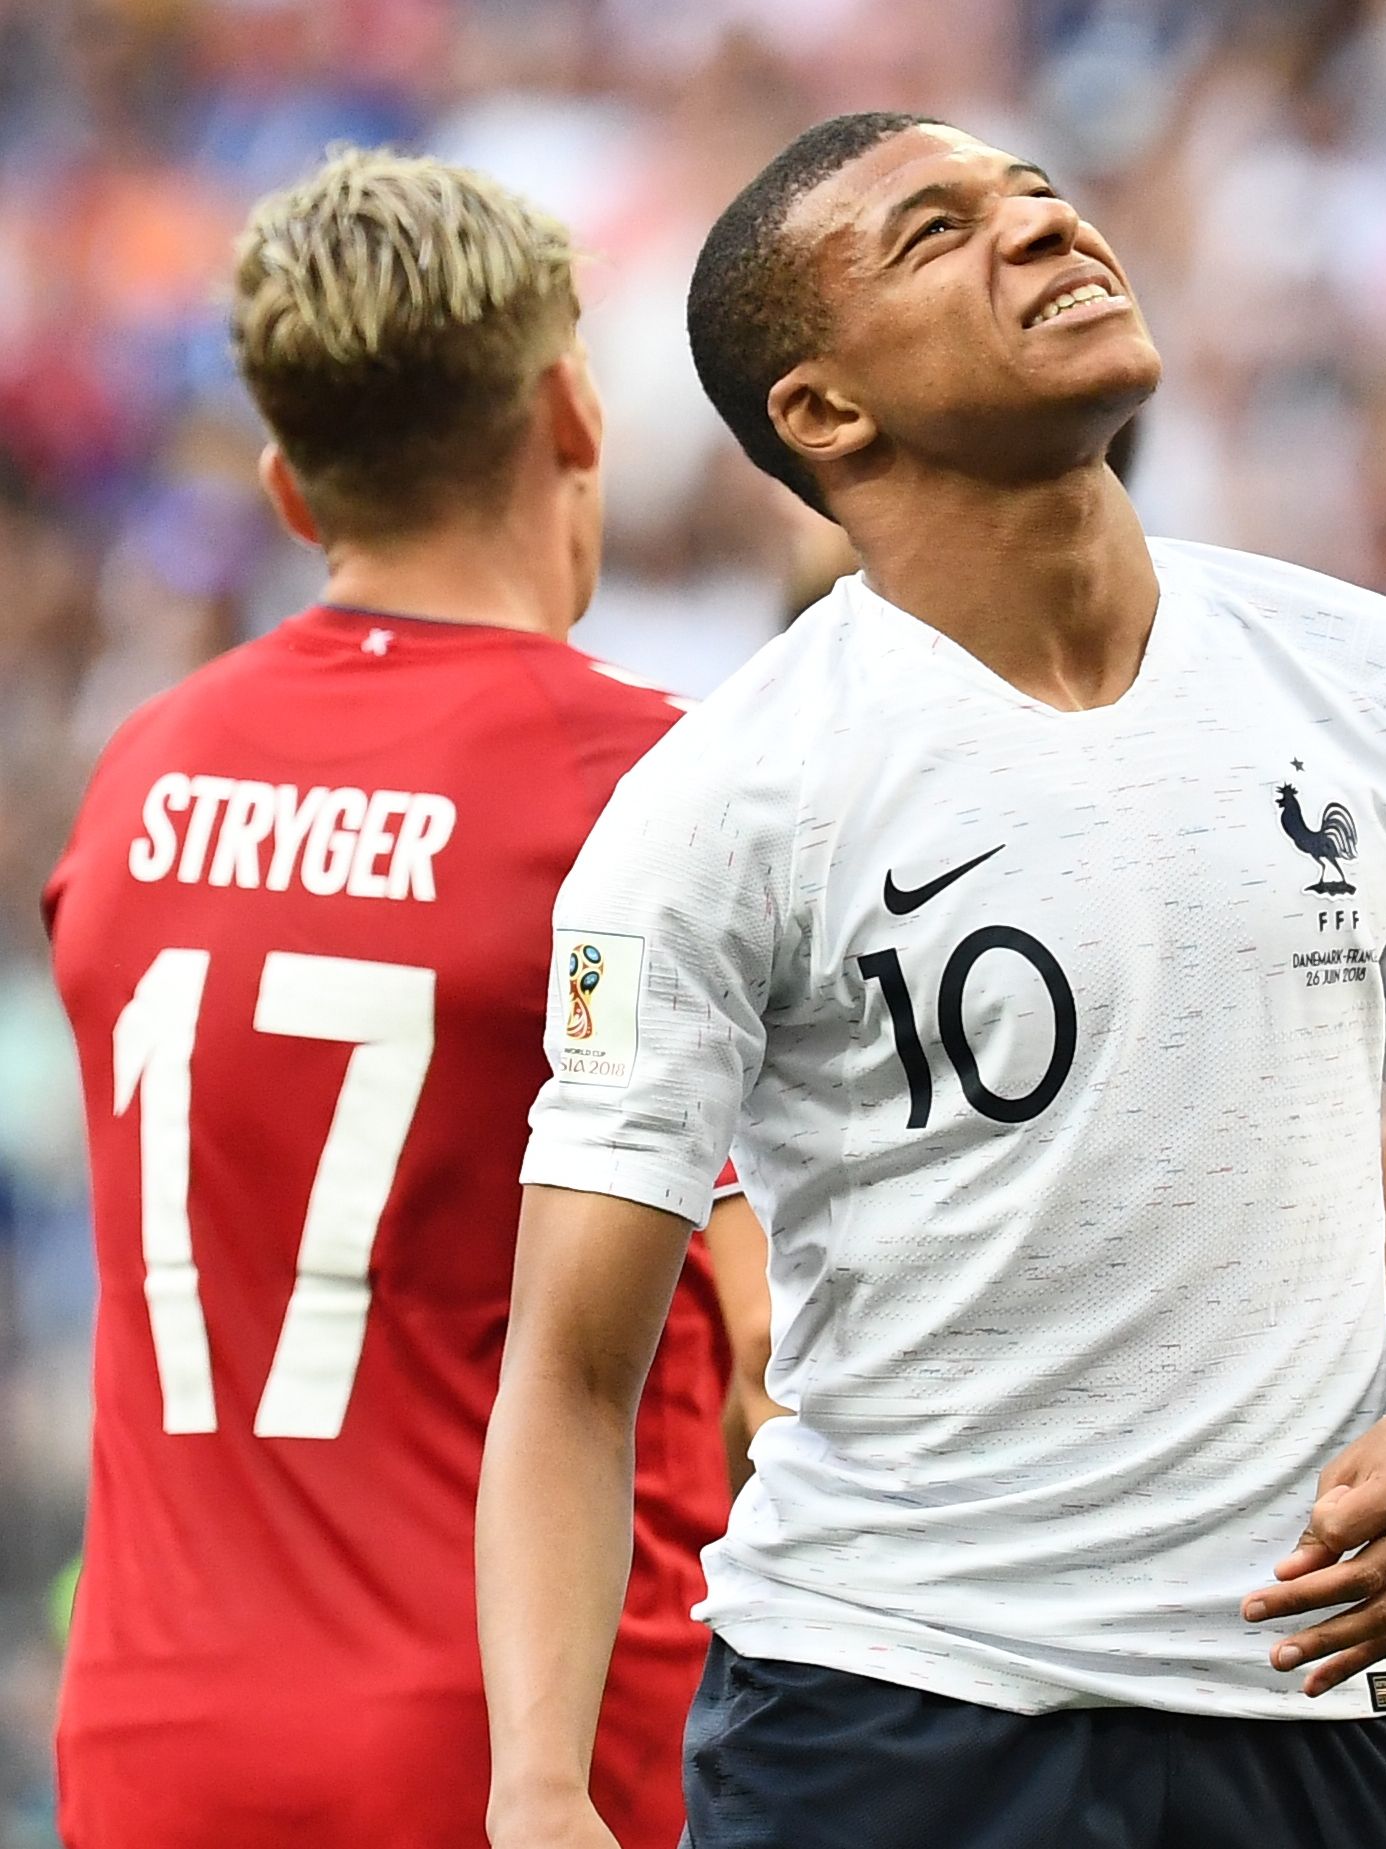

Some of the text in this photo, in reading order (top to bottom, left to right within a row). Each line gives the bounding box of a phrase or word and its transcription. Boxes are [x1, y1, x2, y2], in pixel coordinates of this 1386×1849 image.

[128, 772, 457, 902] STRYGER
[856, 924, 1078, 1130] 10
[1306, 970, 1320, 987] 26
[1342, 966, 1367, 983] 2018
[588, 1060, 626, 1077] 2018
[112, 946, 437, 1440] 17
